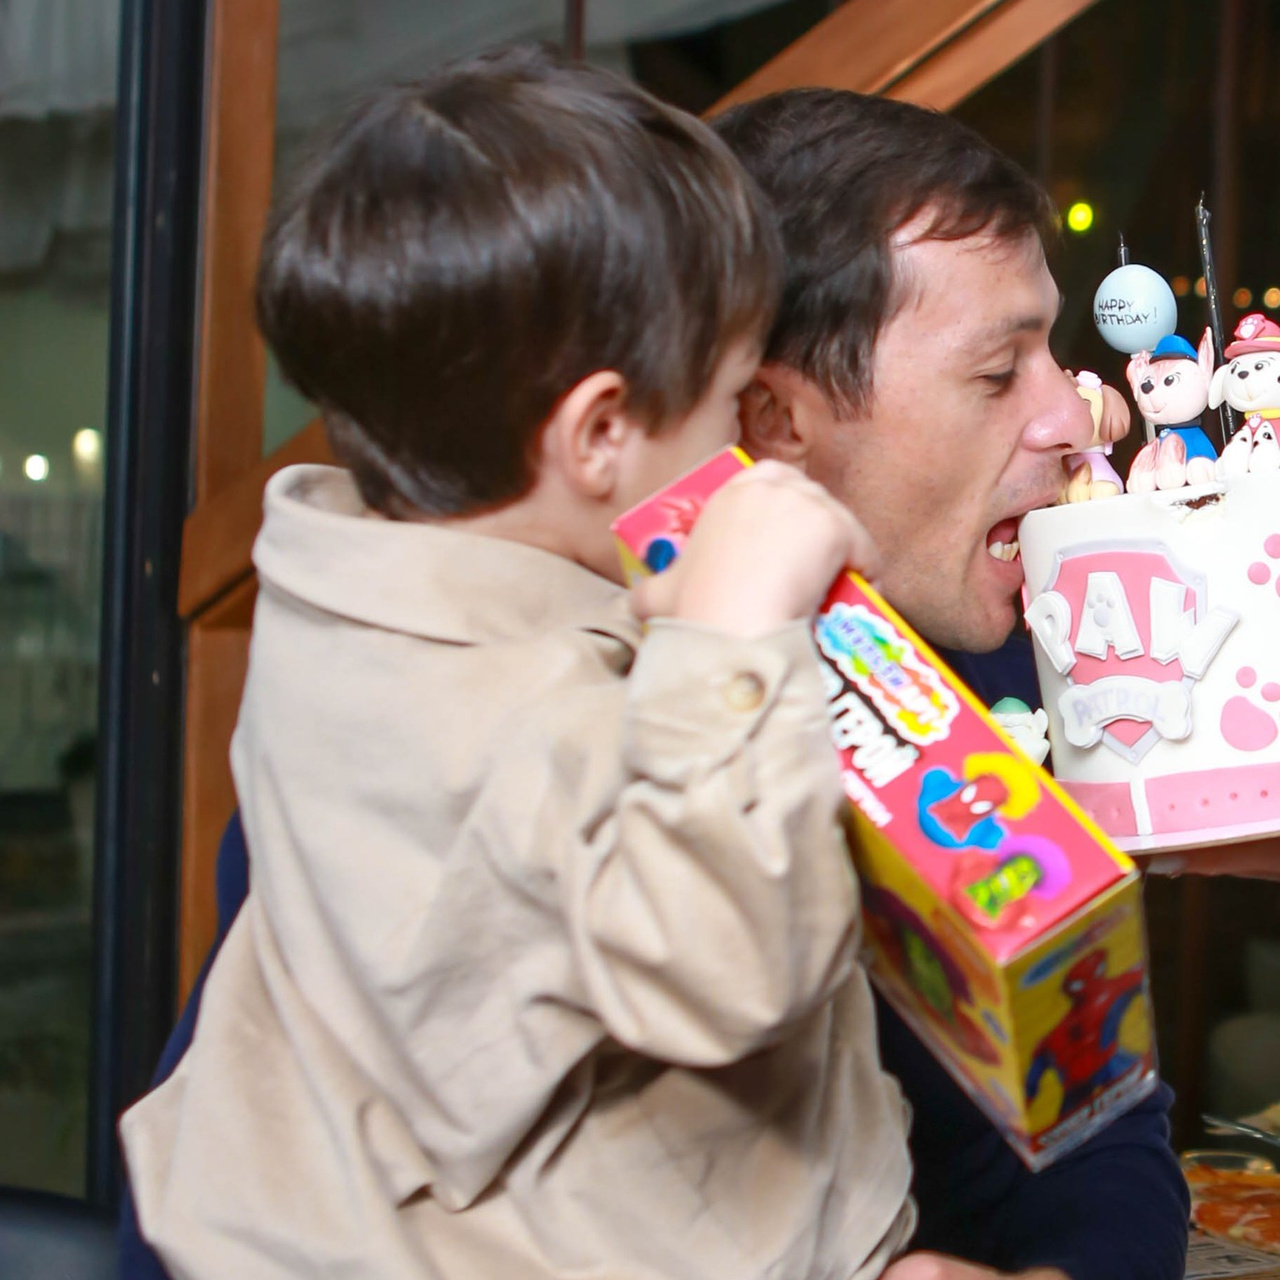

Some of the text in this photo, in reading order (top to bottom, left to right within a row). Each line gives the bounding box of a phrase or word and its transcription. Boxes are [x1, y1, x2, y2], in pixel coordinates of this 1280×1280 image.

[1099, 299, 1134, 312] HAPPY
[1024, 572, 1241, 680] PAW
[1072, 686, 1166, 727] PATROL
